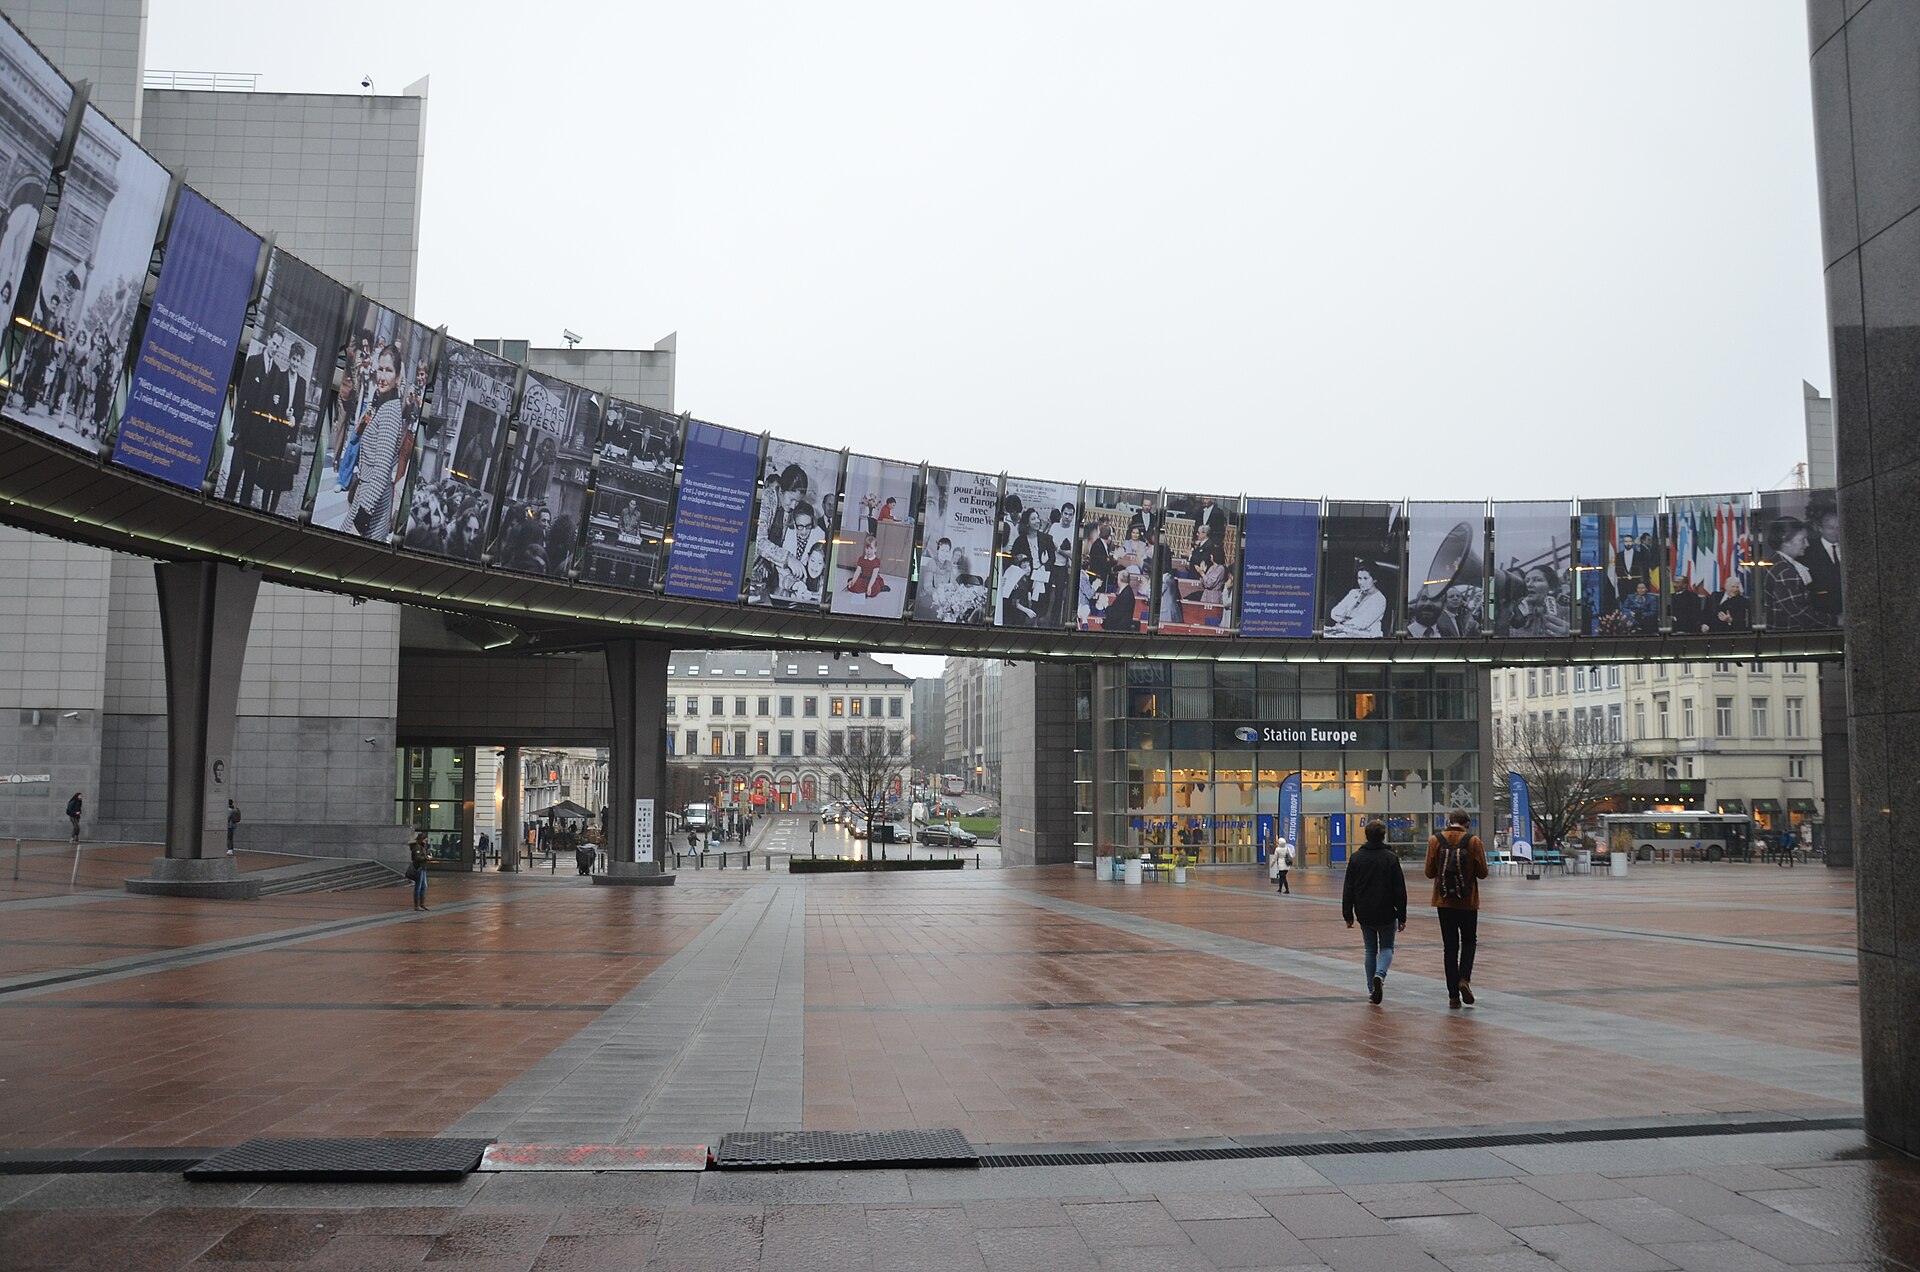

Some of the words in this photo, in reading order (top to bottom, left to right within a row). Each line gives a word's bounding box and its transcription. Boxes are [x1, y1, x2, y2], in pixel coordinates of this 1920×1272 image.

[468, 371, 488, 392] NOUS
[480, 395, 496, 409] DES
[544, 402, 564, 422] PAS
[974, 487, 981, 495] la
[970, 496, 994, 508] Europ
[955, 512, 984, 524] Simone
[1263, 728, 1306, 742] Station
[1311, 728, 1357, 744] Europe
[1132, 818, 1178, 830] Welcome
